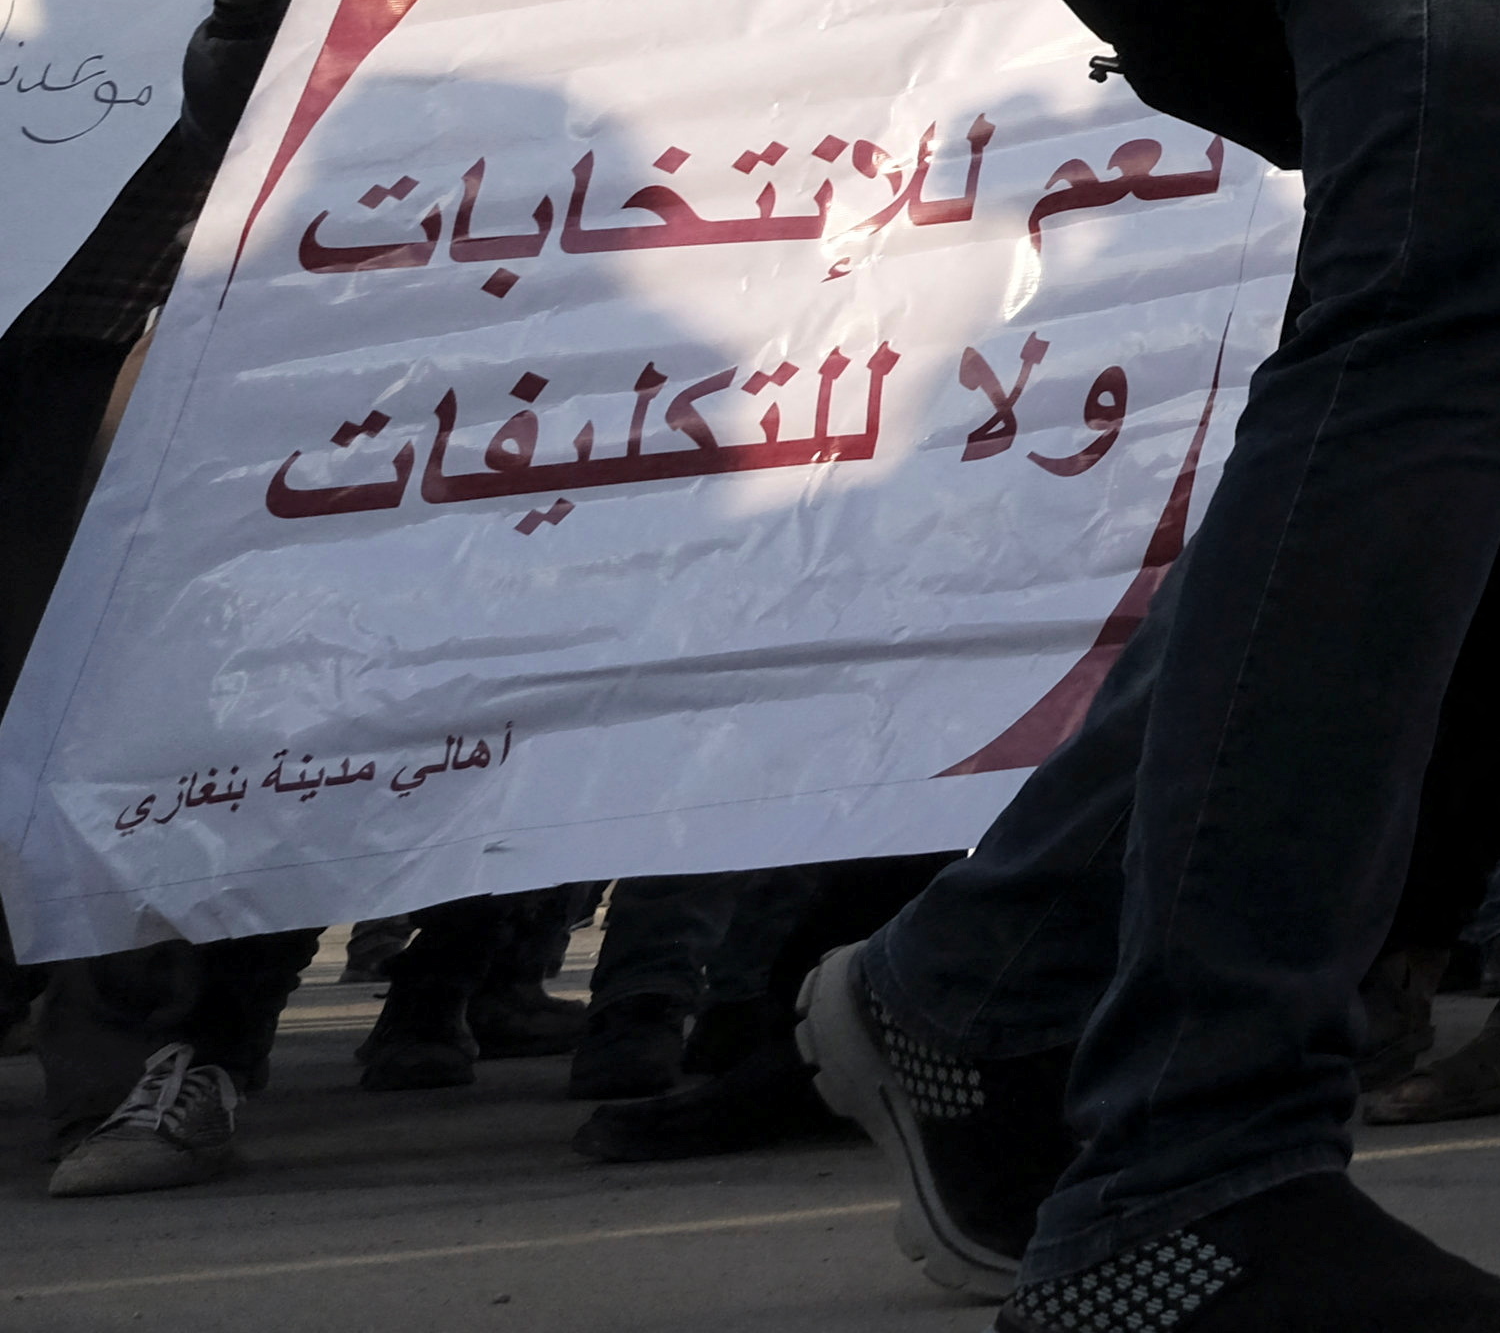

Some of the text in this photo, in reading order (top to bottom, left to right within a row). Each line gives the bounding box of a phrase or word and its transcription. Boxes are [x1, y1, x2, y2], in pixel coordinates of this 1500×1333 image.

[298, 112, 1225, 321] نعم للإنتخابات
[265, 330, 1129, 535] ولا للتكليفات
[114, 721, 515, 837] أهالي مدينة بنغازي
